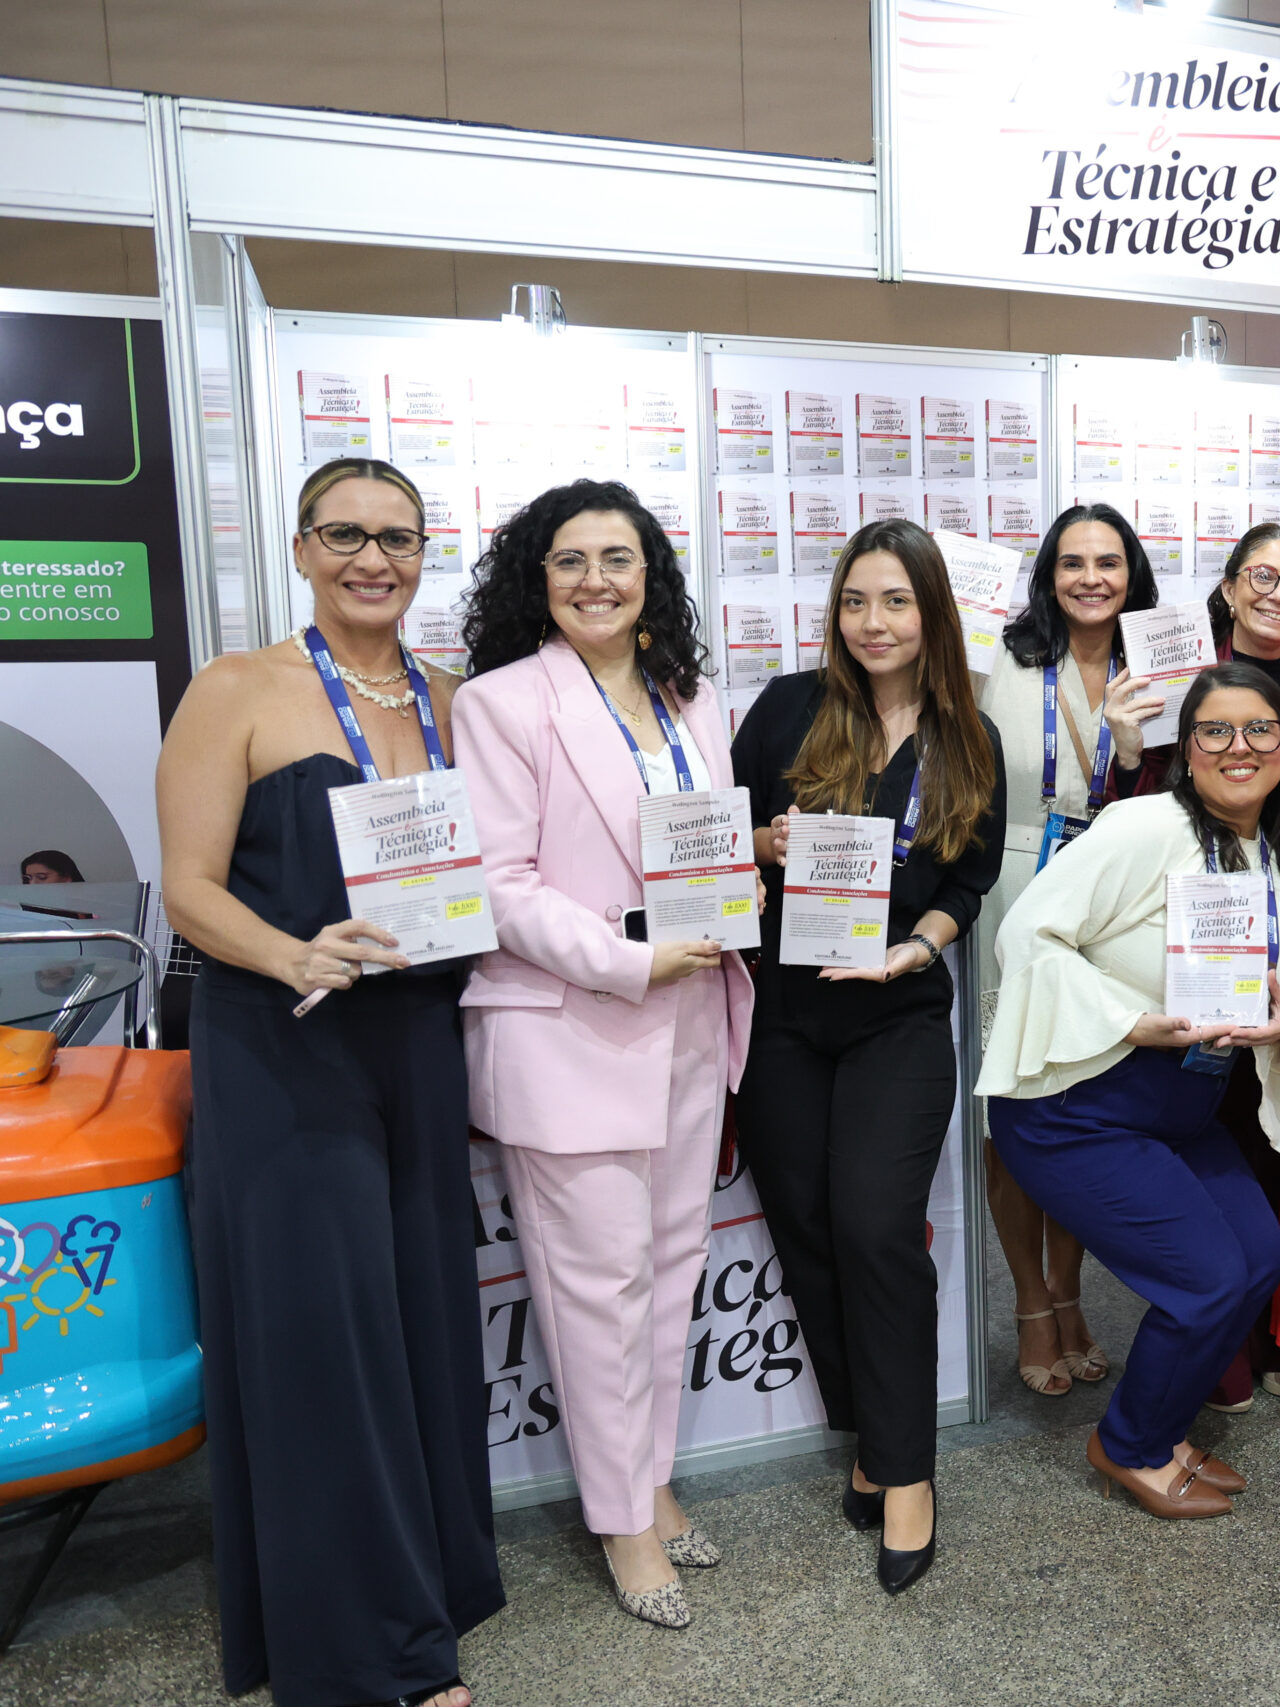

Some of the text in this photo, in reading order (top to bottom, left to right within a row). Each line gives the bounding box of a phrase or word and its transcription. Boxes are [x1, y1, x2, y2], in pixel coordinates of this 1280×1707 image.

[1042, 144, 1277, 201] Técnica e
[0, 581, 112, 599] entre em
[19, 606, 120, 621] conosco
[1144, 622, 1196, 644] Assembleia
[1151, 642, 1187, 658] Técnica
[365, 800, 445, 830] Assembleia
[664, 812, 731, 834] Assembleia
[376, 827, 432, 850] Técnica
[672, 832, 728, 852] Técnica e
[808, 840, 873, 853] Assembleia
[815, 858, 867, 870] Técnica e
[1189, 896, 1249, 912] Assembleia
[1194, 916, 1236, 930] Técnica
